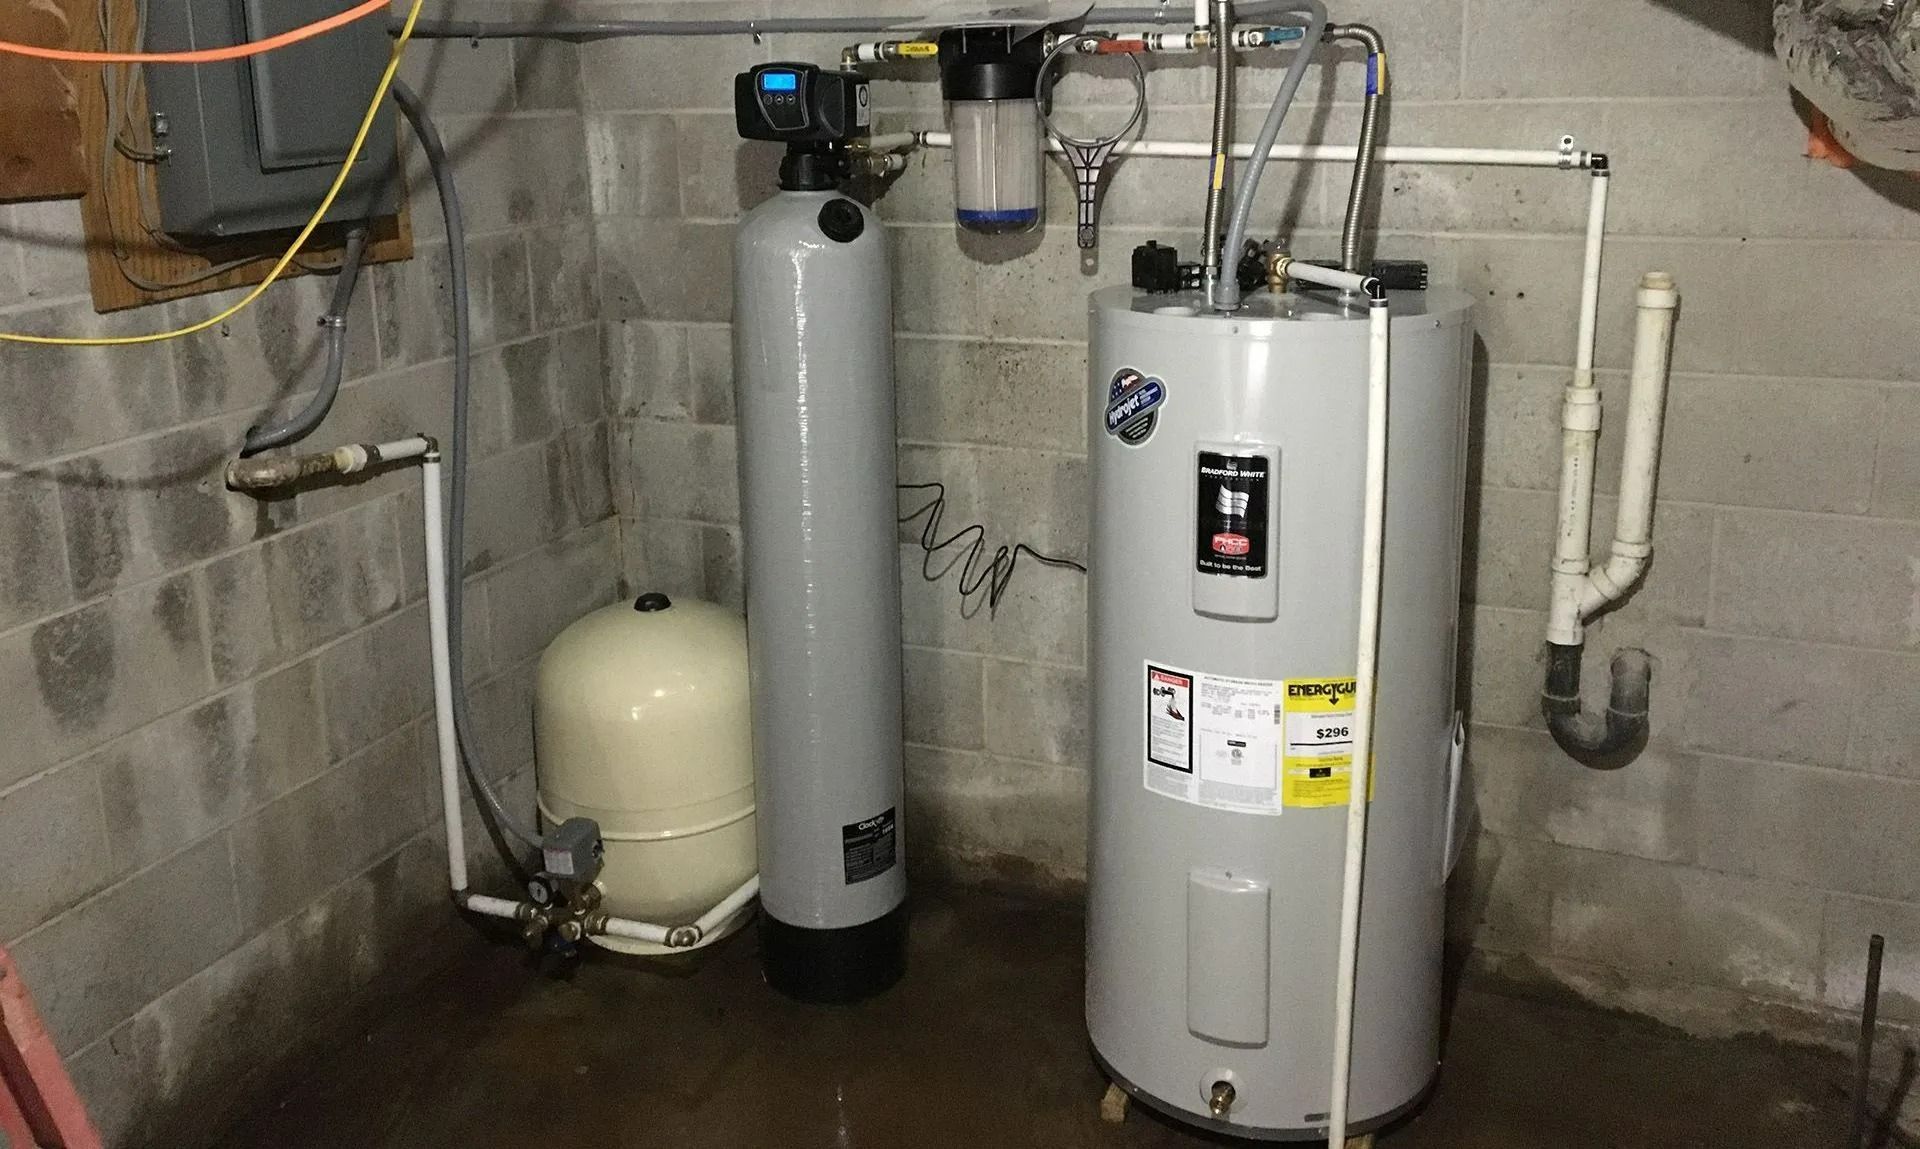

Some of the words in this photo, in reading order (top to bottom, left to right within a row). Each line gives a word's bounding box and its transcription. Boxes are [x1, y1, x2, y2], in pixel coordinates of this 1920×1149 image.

[1201, 466, 1239, 477] BRADFORD
[1240, 470, 1265, 478] WHITE
[1316, 726, 1349, 740] $296
